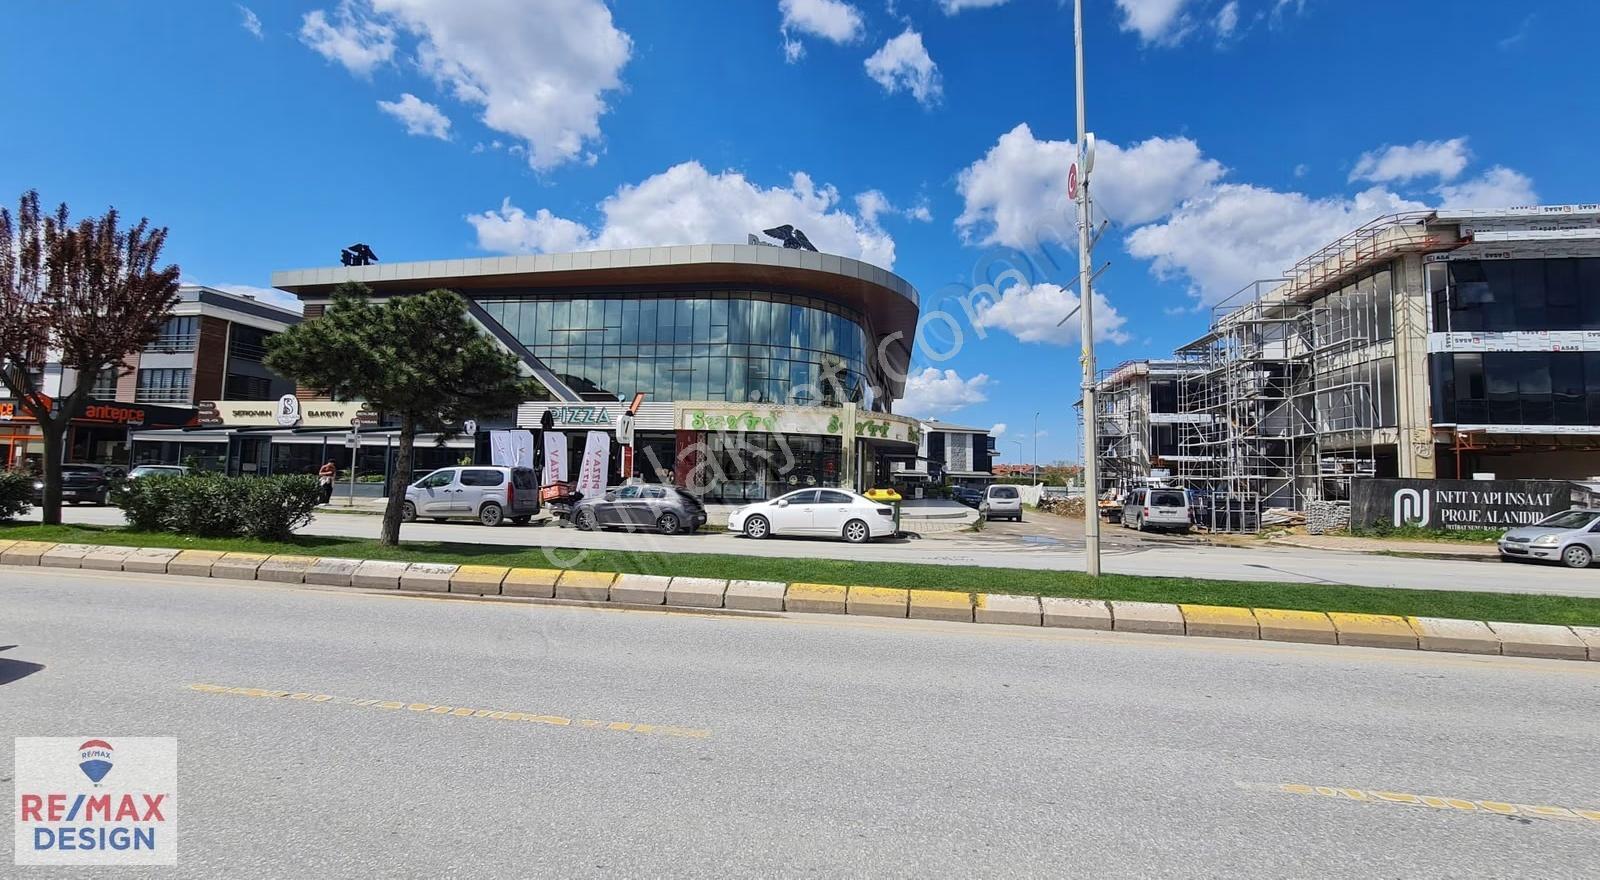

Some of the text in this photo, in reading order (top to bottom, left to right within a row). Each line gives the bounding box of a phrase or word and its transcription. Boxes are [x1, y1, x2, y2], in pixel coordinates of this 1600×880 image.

[307, 410, 345, 418] BAKERY
[548, 406, 613, 424] PIZZA
[1471, 491, 1502, 505] YAPI
[1440, 508, 1544, 525] PROJE ALANIDIR
